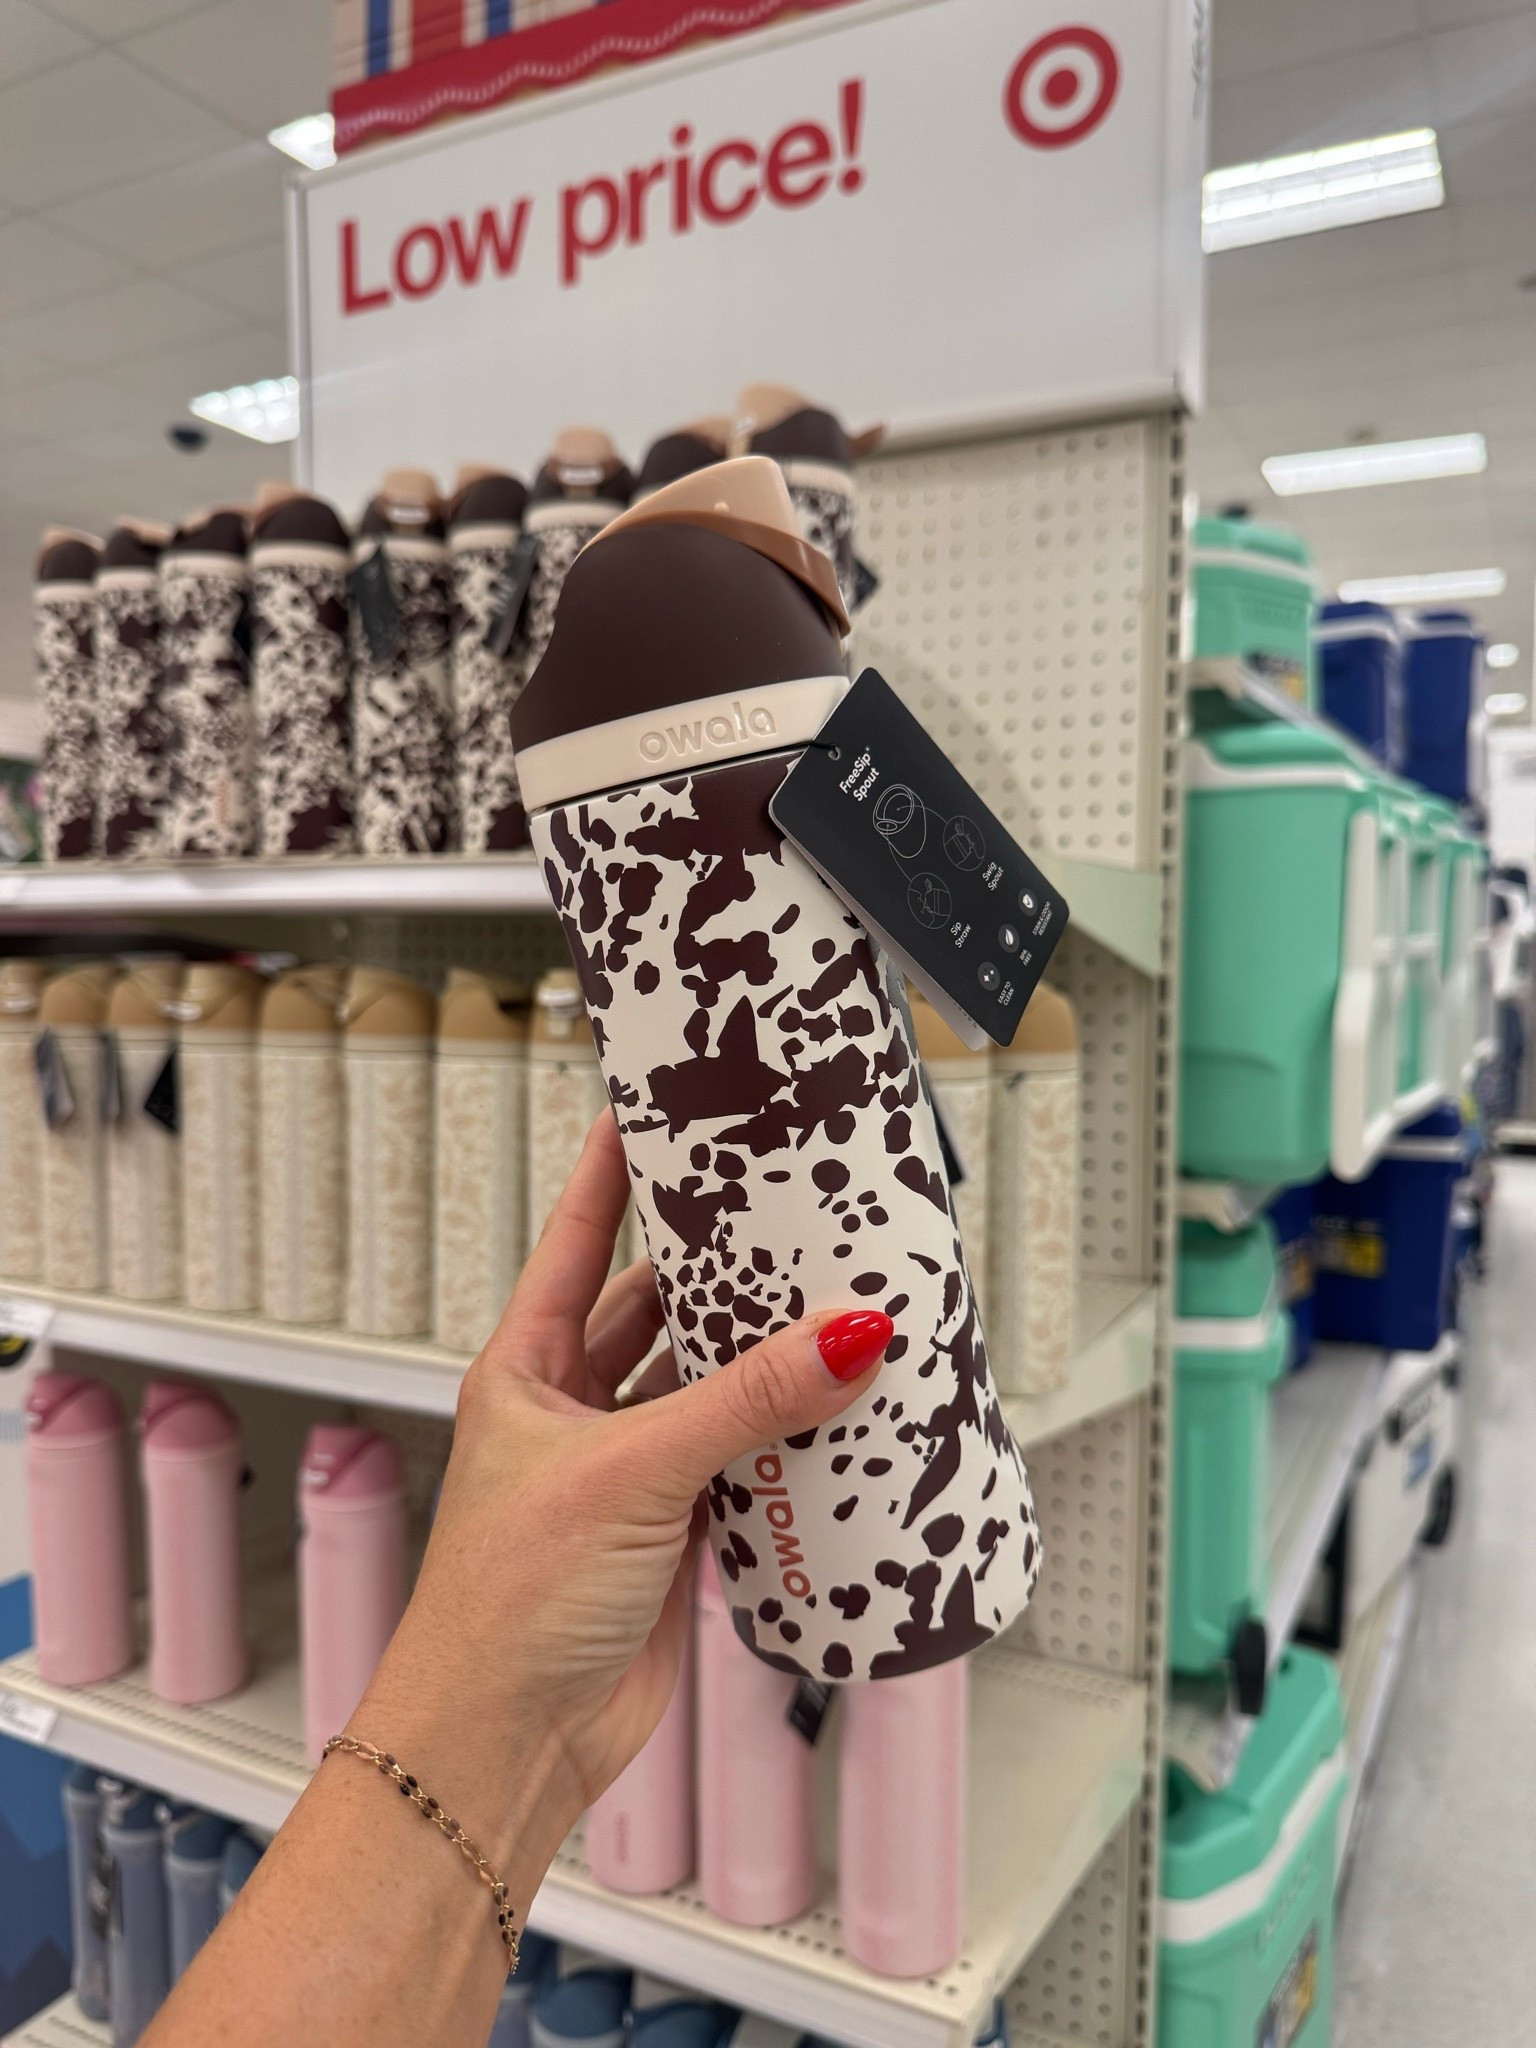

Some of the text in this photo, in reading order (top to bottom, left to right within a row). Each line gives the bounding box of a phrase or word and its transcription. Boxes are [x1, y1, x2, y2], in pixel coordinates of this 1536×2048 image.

[340, 77, 868, 316] Low price!
[639, 701, 777, 763] owala
[839, 752, 871, 794] FreeSip
[853, 767, 880, 802] Spout
[982, 861, 997, 882] Swig
[987, 866, 1004, 891] Spout
[950, 921, 962, 936] Sip
[1032, 920, 1042, 936] STAIN
[1041, 901, 1050, 917] ODOR
[1038, 910, 1052, 936] RESISTANT
[954, 923, 971, 948] Straw
[1019, 949, 1028, 961] BPA
[1022, 952, 1032, 966] FREE
[997, 981, 1011, 1004] EASY TO
[1003, 987, 1014, 1006] CLEAN
[751, 1453, 811, 1598] owala
